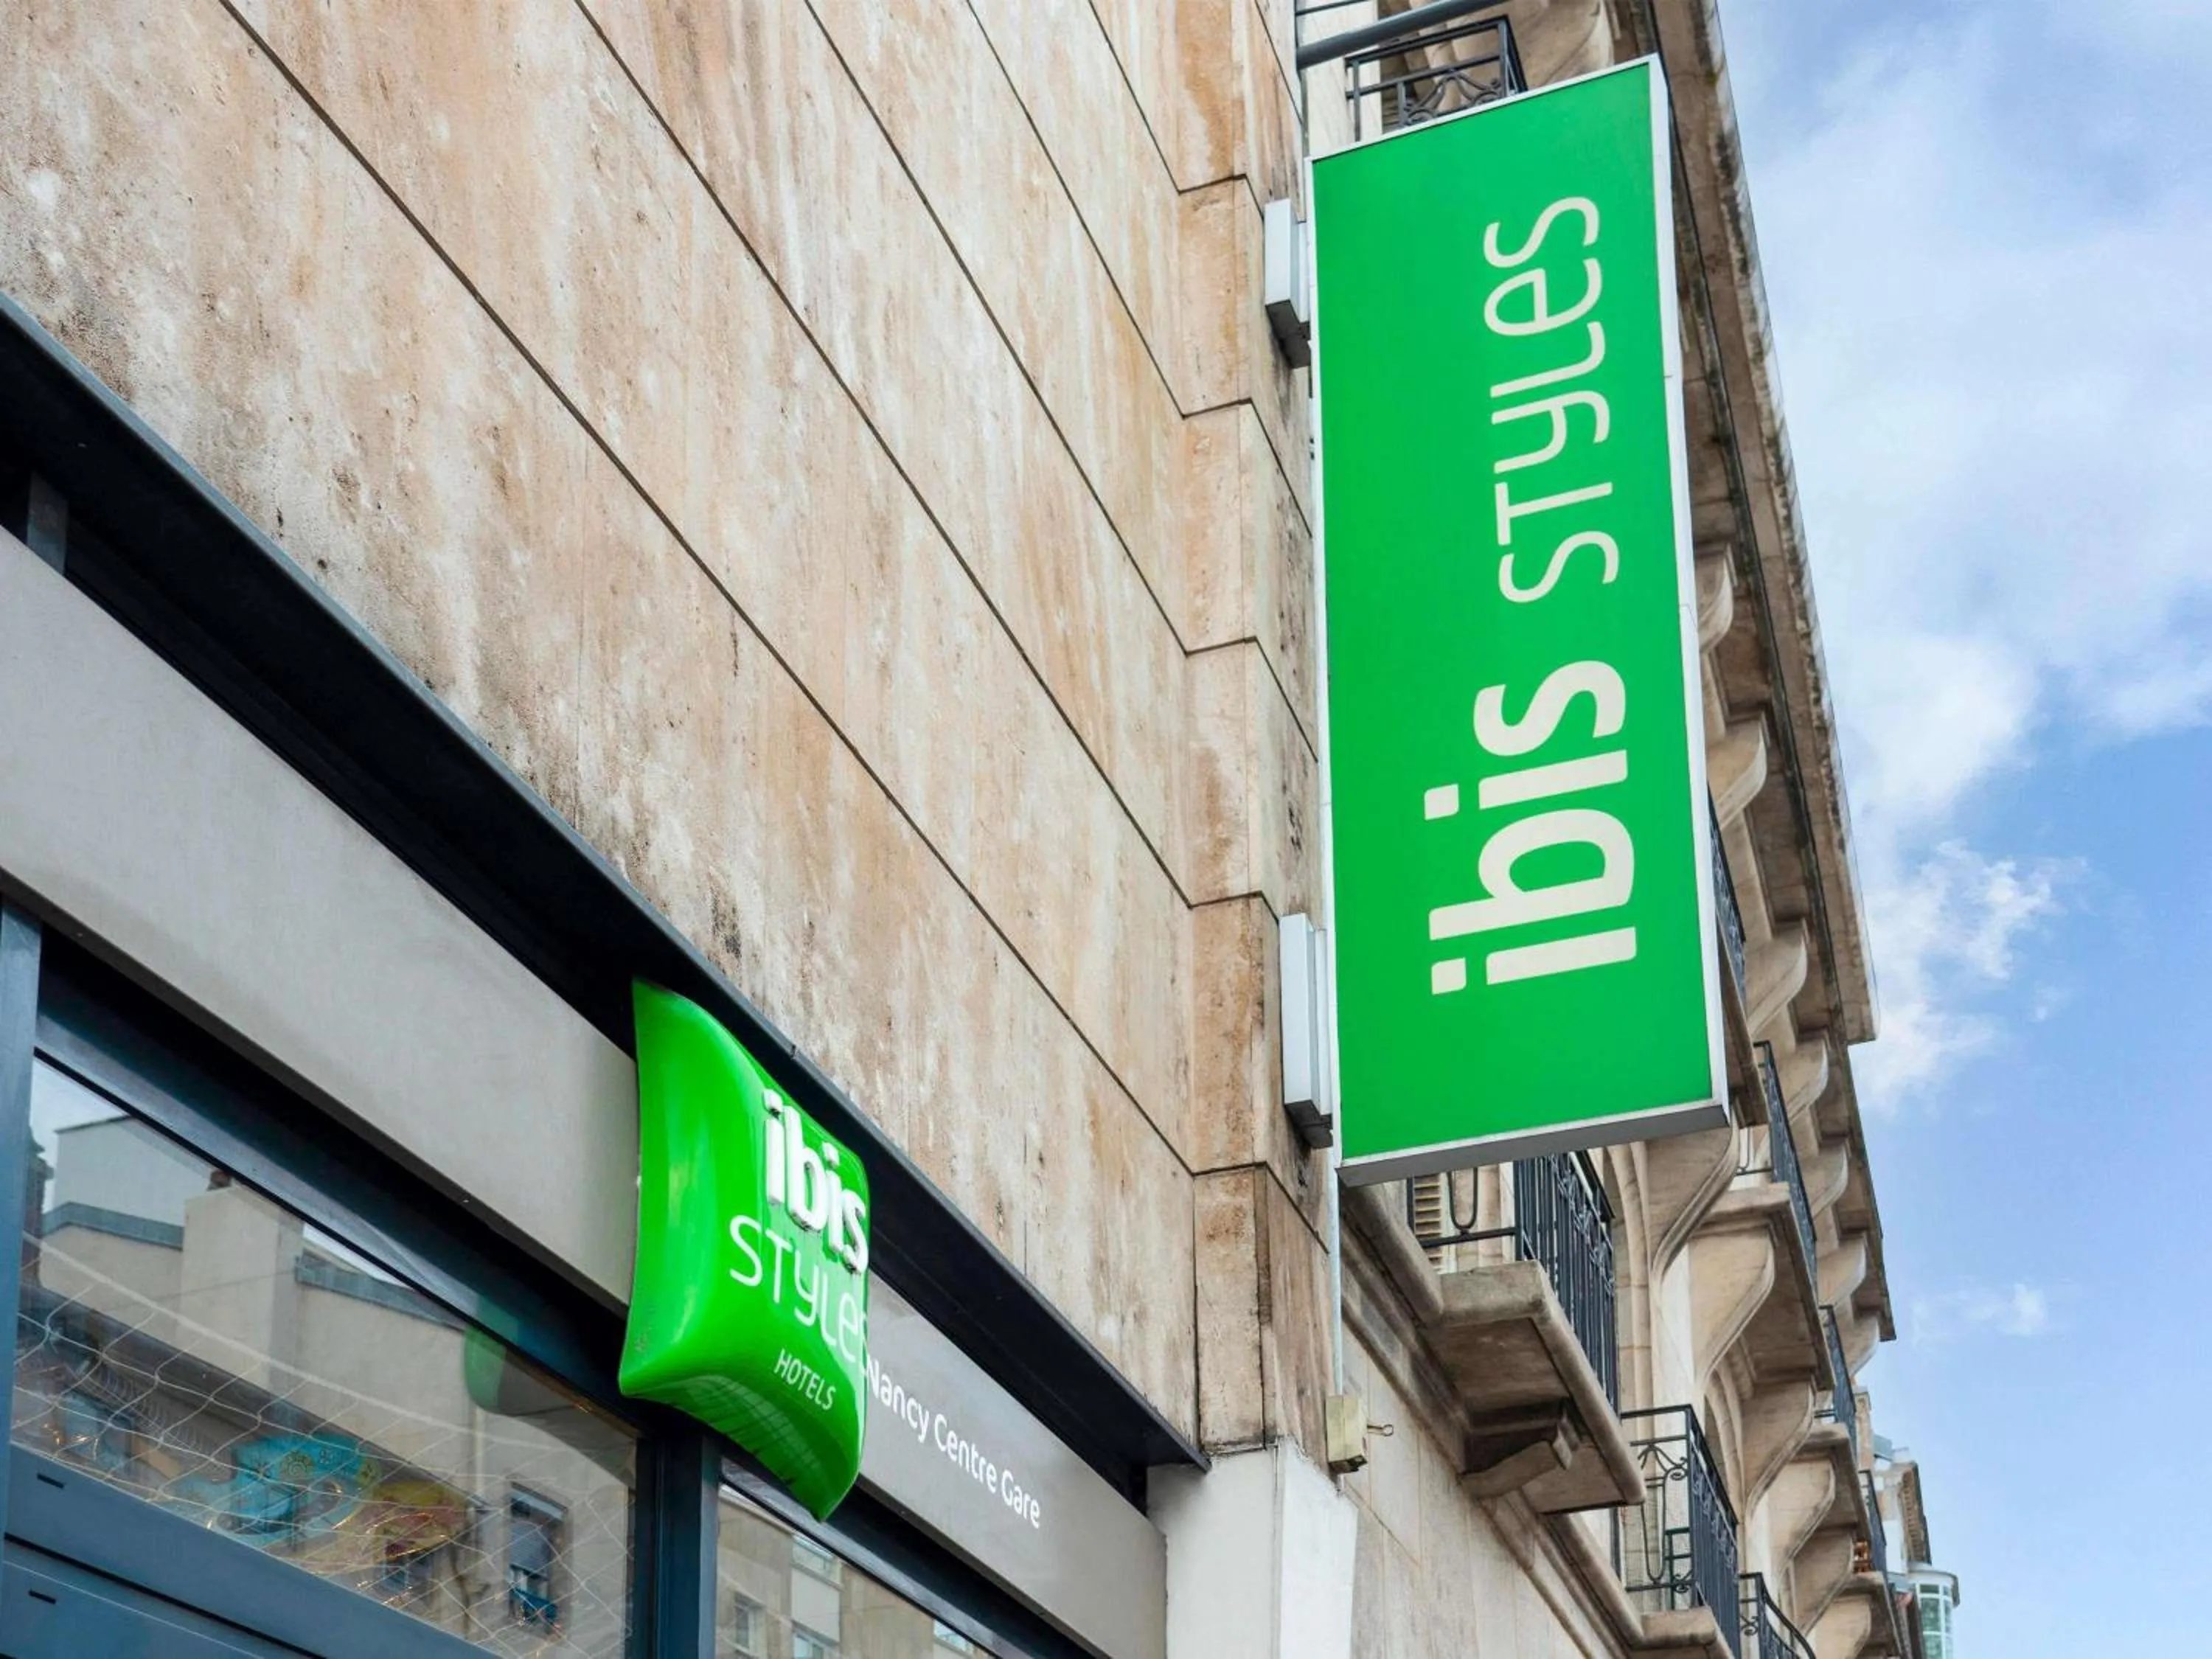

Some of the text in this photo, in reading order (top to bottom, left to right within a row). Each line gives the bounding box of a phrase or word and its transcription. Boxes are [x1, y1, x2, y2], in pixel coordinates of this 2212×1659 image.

[1423, 660, 1638, 995] ibis
[762, 1088, 869, 1276] ibis
[773, 1348, 837, 1411] HOTELS
[866, 1353, 1041, 1529] Nancy Centre Gare
